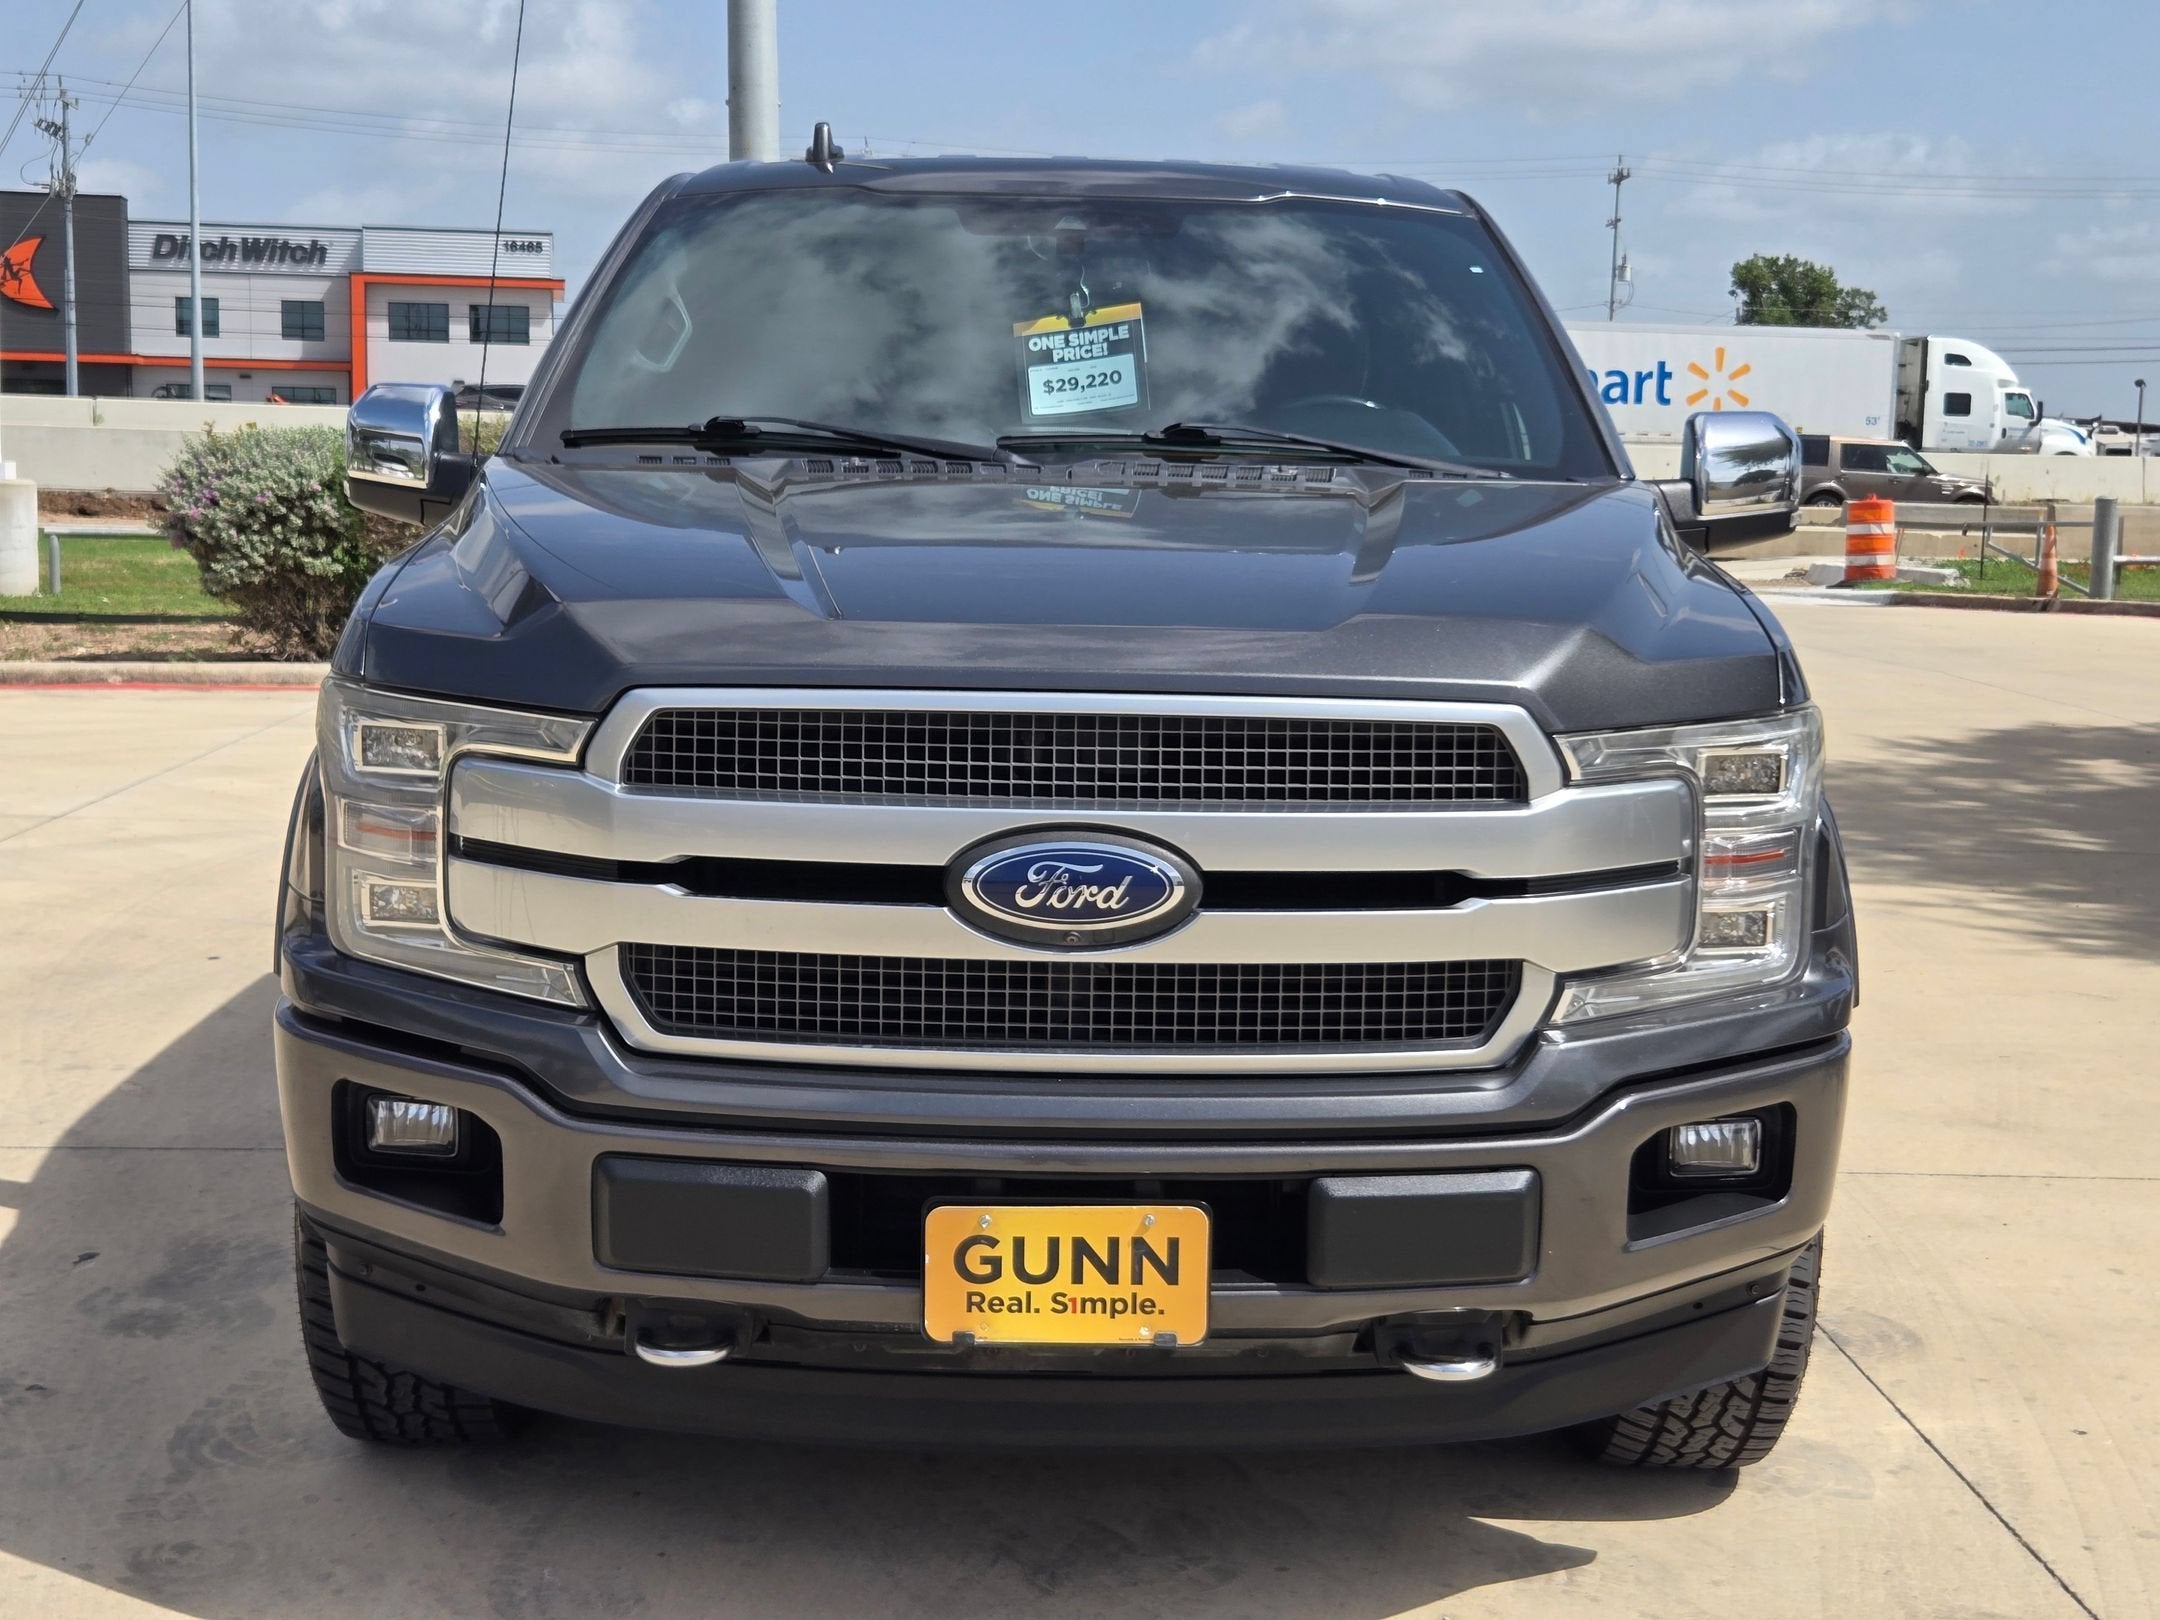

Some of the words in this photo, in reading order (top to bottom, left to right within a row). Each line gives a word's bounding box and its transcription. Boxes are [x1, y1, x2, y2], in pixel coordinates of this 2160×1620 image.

[152, 234, 238, 261] Dich
[1028, 335, 1065, 351] ONE
[1068, 325, 1130, 346] SIMPLE
[1052, 343, 1109, 363] PRICE!
[1042, 370, 1122, 396] $29,220
[1586, 361, 1673, 406] art
[1014, 861, 1133, 910] Ford
[953, 1234, 1180, 1286] GUNN
[966, 1291, 1040, 1314] Real.
